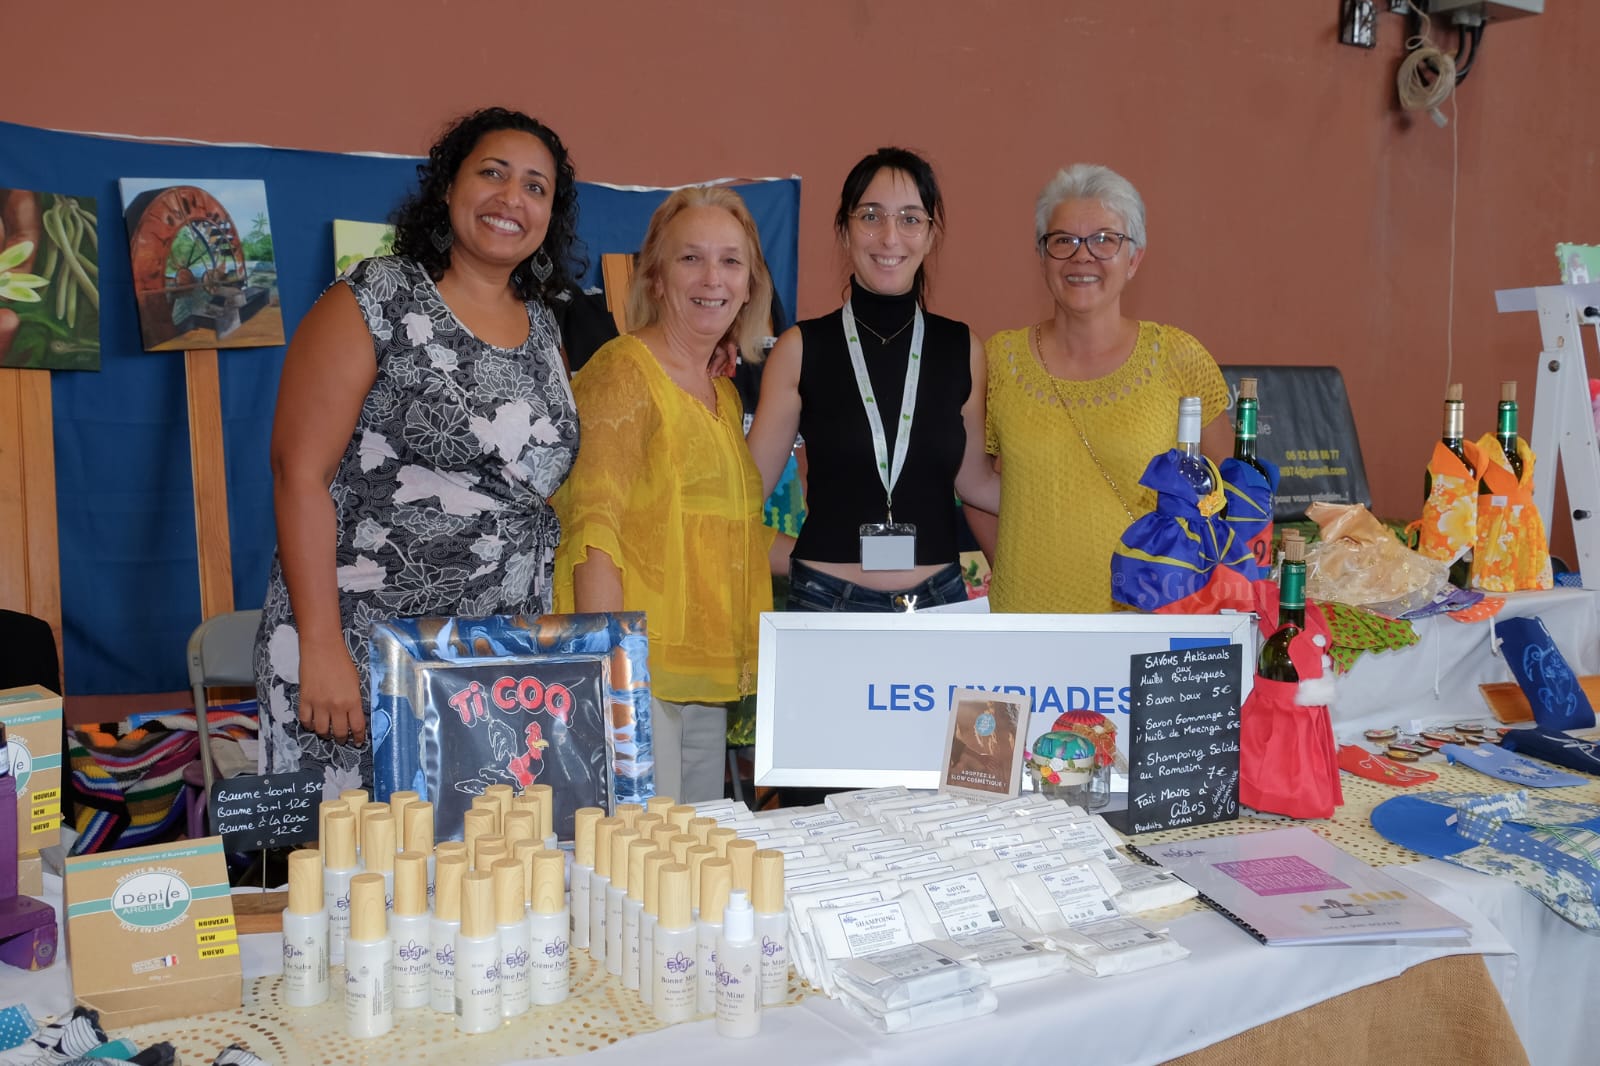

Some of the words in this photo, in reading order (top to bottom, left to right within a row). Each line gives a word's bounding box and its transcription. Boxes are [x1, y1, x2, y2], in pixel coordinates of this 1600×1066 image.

[1172, 670, 1226, 683] Biologiques
[449, 682, 488, 726] Ti
[491, 676, 575, 728] COQ
[868, 684, 935, 712] LES
[949, 685, 1130, 715] IADES
[1145, 694, 1175, 706] Savon
[1180, 692, 1202, 702] Doux
[1145, 718, 1173, 730] Savon
[1175, 711, 1223, 725] Gommage
[1169, 729, 1181, 738] de
[1146, 749, 1206, 766] Shampoing
[1209, 741, 1240, 755] Solide
[1140, 772, 1154, 780] au
[1158, 763, 1203, 776] Romarin
[218, 790, 262, 802] Baume
[1134, 793, 1157, 809] Fait
[1160, 788, 1191, 801] Mains
[1199, 780, 1209, 795] à
[217, 807, 253, 818] Baume
[1170, 799, 1206, 818] Cilaos
[218, 823, 256, 834] Baume
[283, 814, 310, 823] Rose
[198, 918, 229, 928] NOUVEAU
[200, 934, 216, 942] NEW
[202, 948, 225, 957] NUEVO
